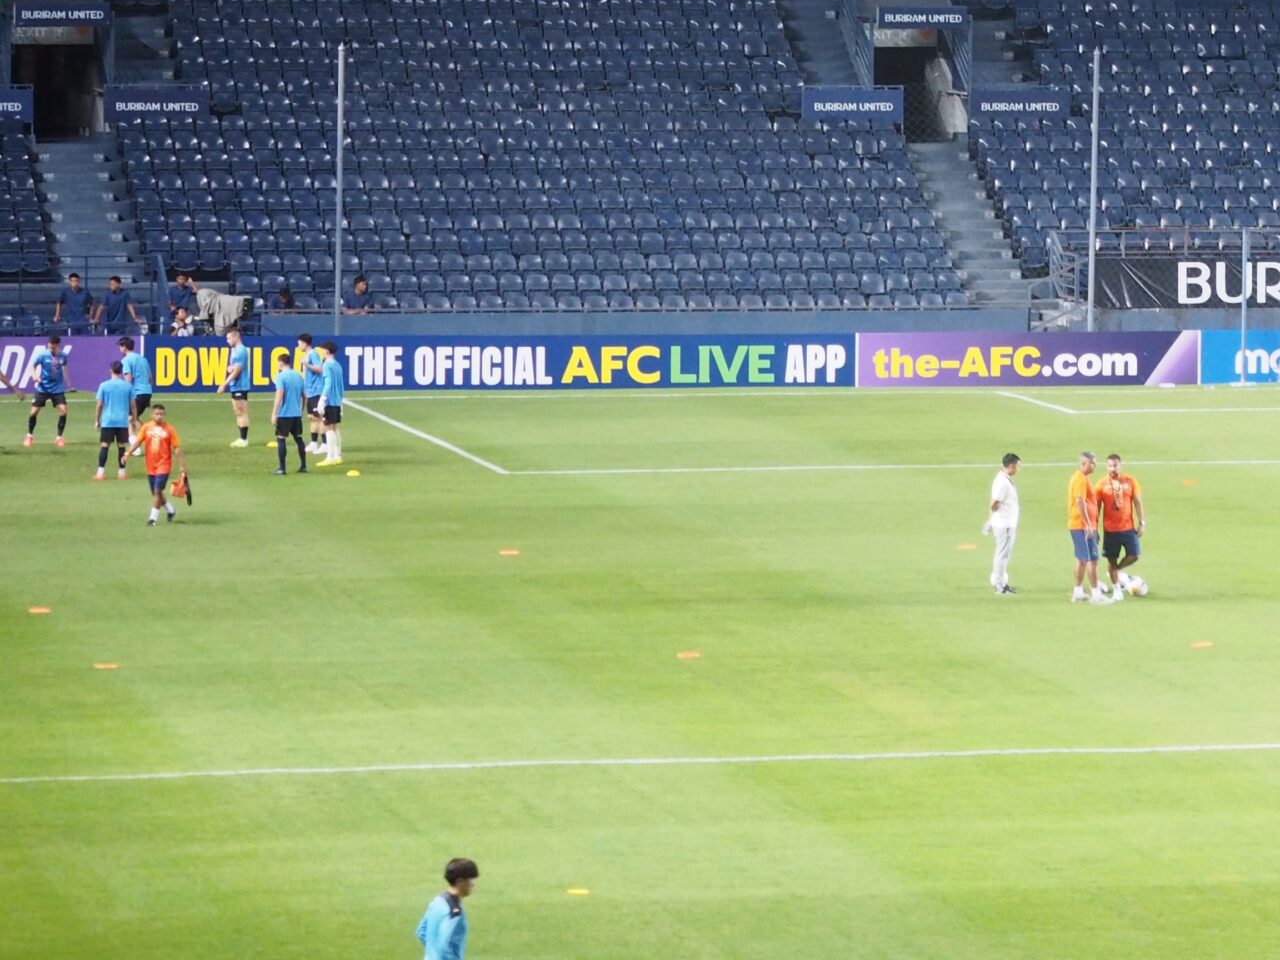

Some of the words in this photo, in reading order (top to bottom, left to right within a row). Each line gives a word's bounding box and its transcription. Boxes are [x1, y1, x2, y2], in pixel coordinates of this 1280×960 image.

[21, 10, 67, 20] BURIRAM
[68, 10, 104, 20] UNITED
[884, 13, 927, 24] BURIRAM
[928, 13, 963, 24] UNITED
[115, 101, 161, 112] BURIRAM
[162, 101, 199, 112] UNITED
[813, 102, 858, 112] BURIRAM
[858, 102, 894, 112] UNITED
[980, 102, 1024, 112] BURIRAM
[1025, 102, 1060, 112] UNITED
[345, 346, 403, 386] THE
[414, 346, 552, 386] OFFICIAL
[561, 345, 661, 385] AFC
[669, 345, 776, 384] LIVE
[785, 344, 846, 384] APP
[872, 346, 1138, 378] the-AFC.com
